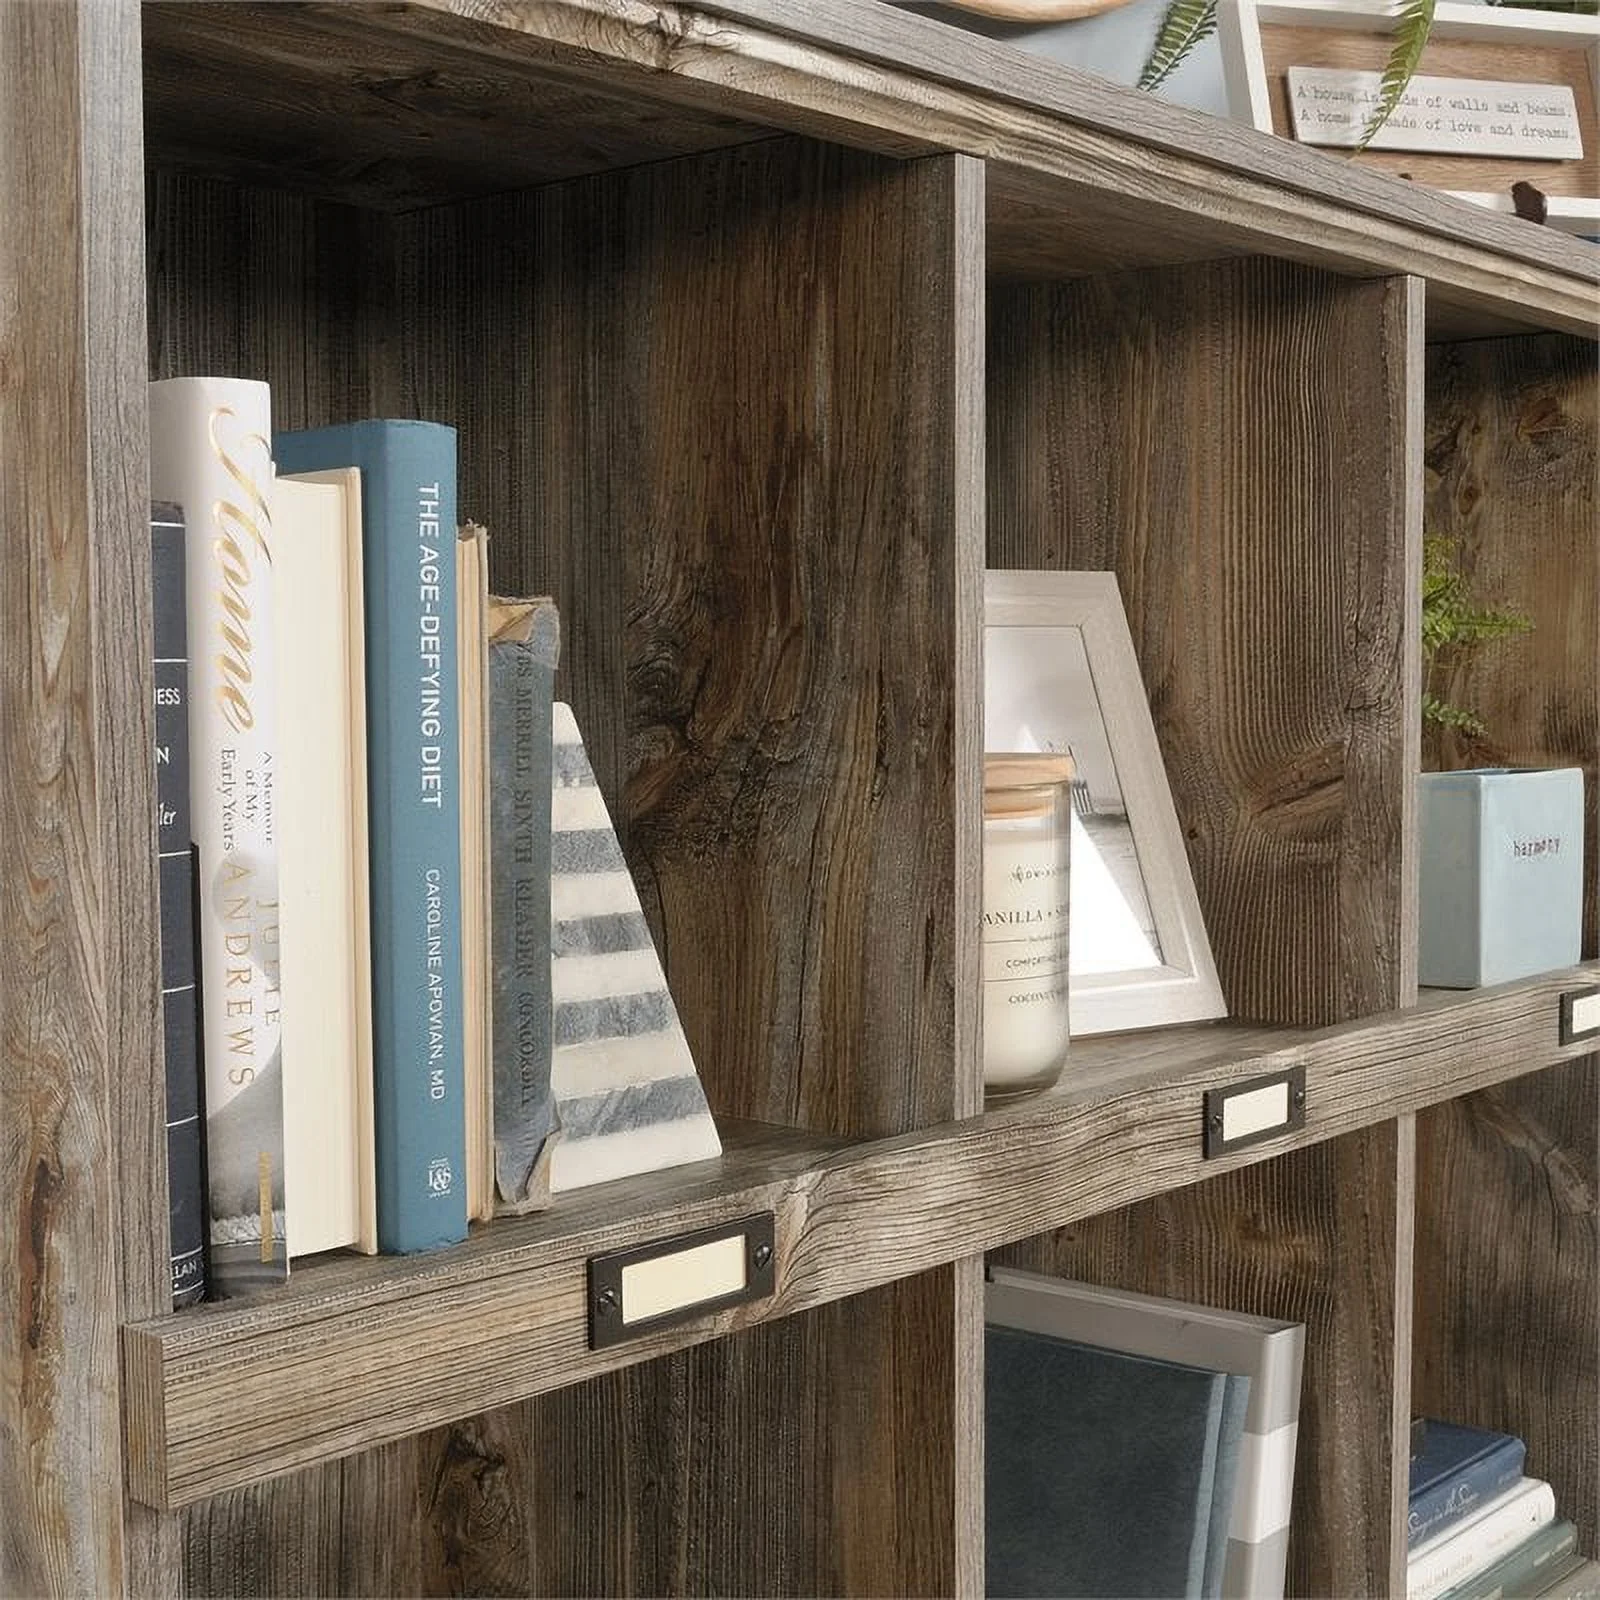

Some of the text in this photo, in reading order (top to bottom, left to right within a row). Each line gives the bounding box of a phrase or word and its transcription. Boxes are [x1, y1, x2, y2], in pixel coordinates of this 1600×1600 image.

[1297, 85, 1307, 98] A
[1425, 96, 1442, 109] of
[1450, 98, 1489, 112] walls
[1497, 102, 1520, 114] and
[1301, 109, 1311, 121] A
[1425, 119, 1442, 131] of
[1450, 120, 1482, 134] love
[1490, 124, 1514, 136] and
[418, 481, 443, 809] THE AGE-DEFYING DIET
[215, 748, 238, 852] Early Years
[513, 789, 534, 864] SIXTH
[424, 868, 443, 970] CAROLINE
[223, 860, 256, 1087] ANDREWS
[430, 1068, 446, 1101] MD
